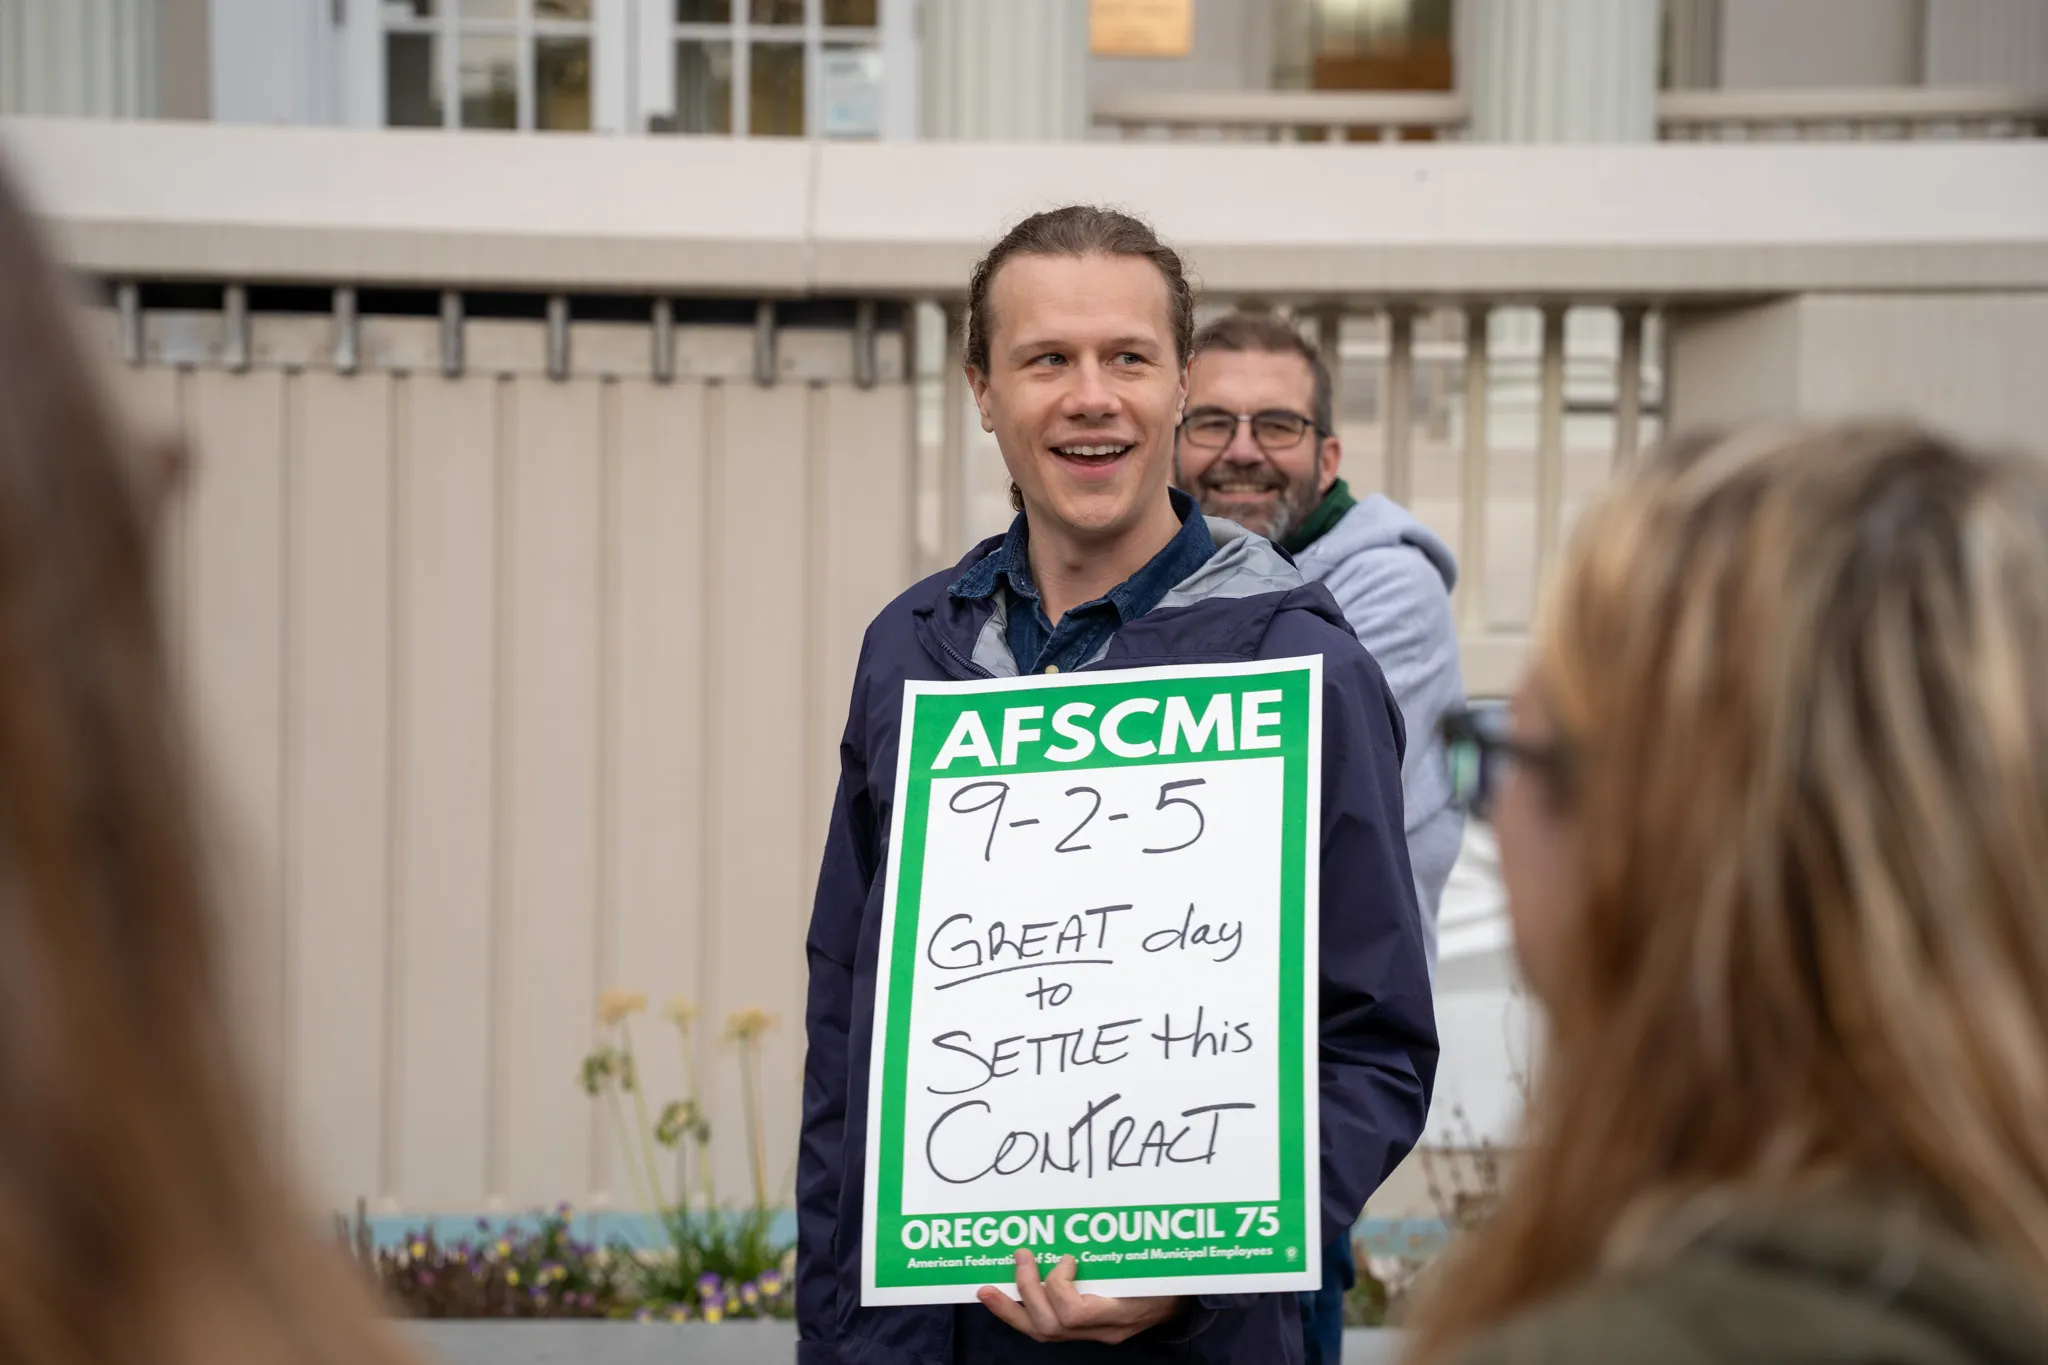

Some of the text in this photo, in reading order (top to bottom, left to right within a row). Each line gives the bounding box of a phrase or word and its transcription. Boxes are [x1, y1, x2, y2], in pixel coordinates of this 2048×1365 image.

[931, 689, 1283, 770] AFSCME
[949, 778, 1207, 862] 9-2-5
[928, 903, 1243, 970] GREAT day
[1026, 976, 1072, 1010] to
[926, 1006, 1254, 1095] SETTLE this
[926, 1093, 1256, 1184] CONTRACT
[901, 1206, 1281, 1250] OREGON COUNCIL 75
[907, 1257, 963, 1269] American
[965, 1253, 1017, 1267] Federati
[1081, 1250, 1122, 1264] County
[1125, 1248, 1149, 1261] and
[1150, 1246, 1207, 1261] Municipal
[1209, 1245, 1273, 1261] Employees
